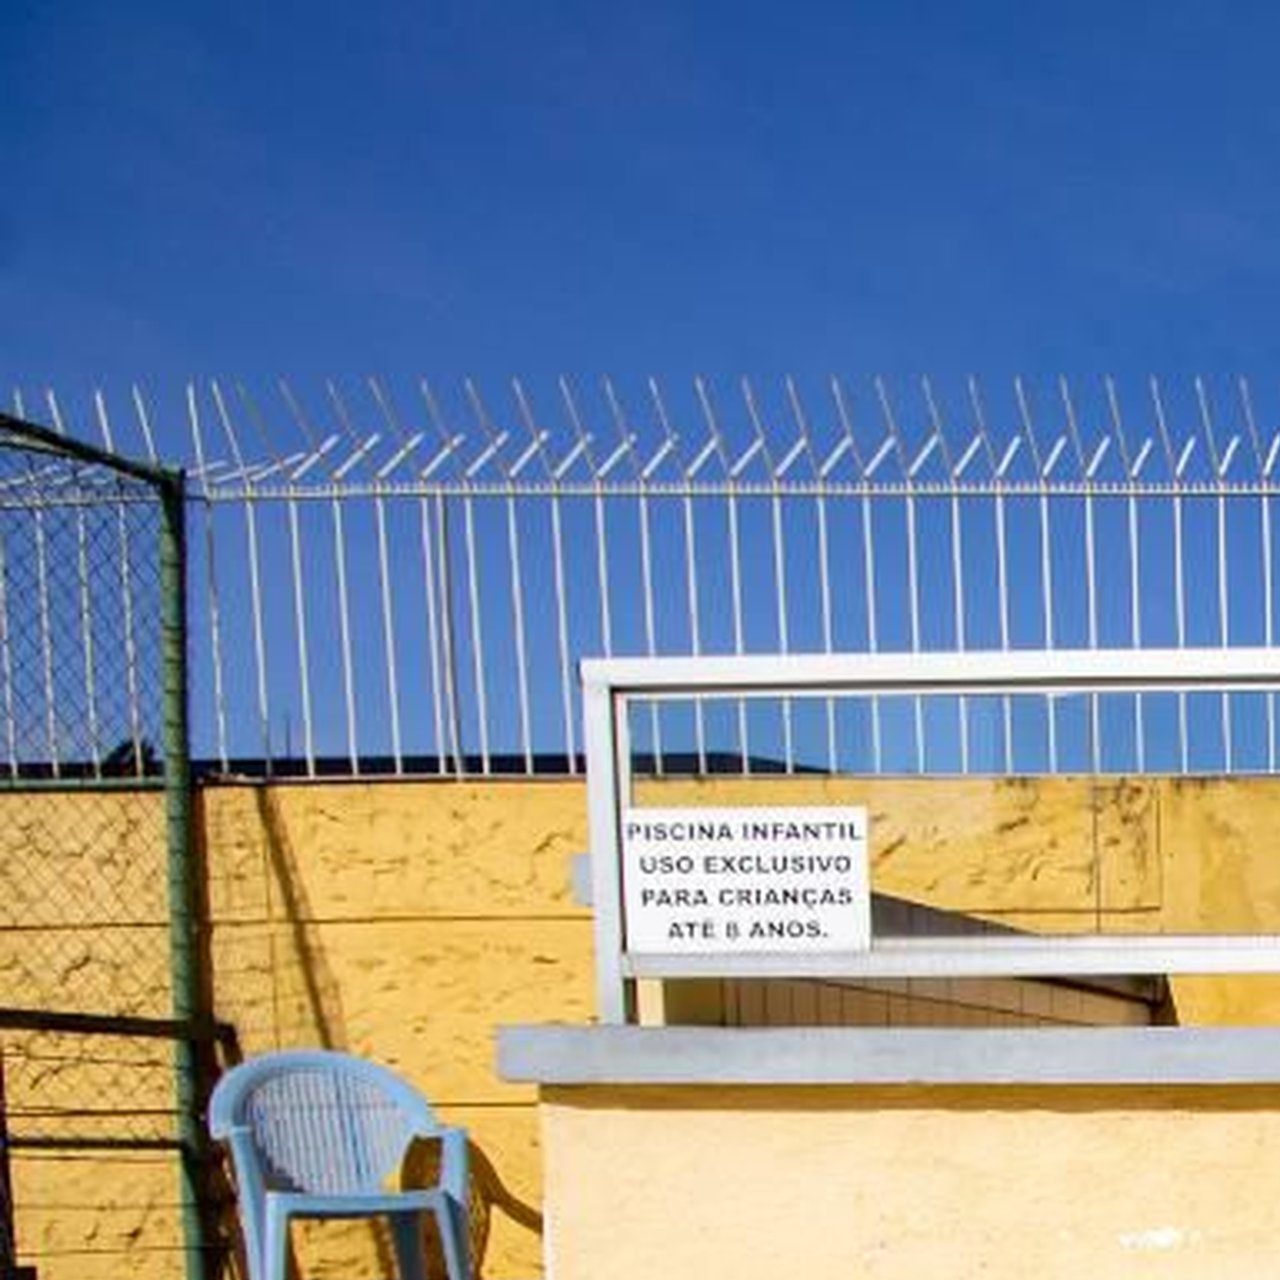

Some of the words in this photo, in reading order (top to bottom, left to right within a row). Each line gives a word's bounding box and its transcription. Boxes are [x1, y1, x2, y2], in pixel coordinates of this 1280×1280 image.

[628, 822, 733, 841] PISCINA
[742, 822, 863, 841] INFANTIL
[639, 855, 694, 875] USO
[703, 855, 852, 875] EXCLUSIVO
[641, 889, 707, 907] PARA
[718, 888, 853, 910] CRIANÇAS
[726, 921, 740, 940] 8
[749, 920, 828, 939] ANOS.
